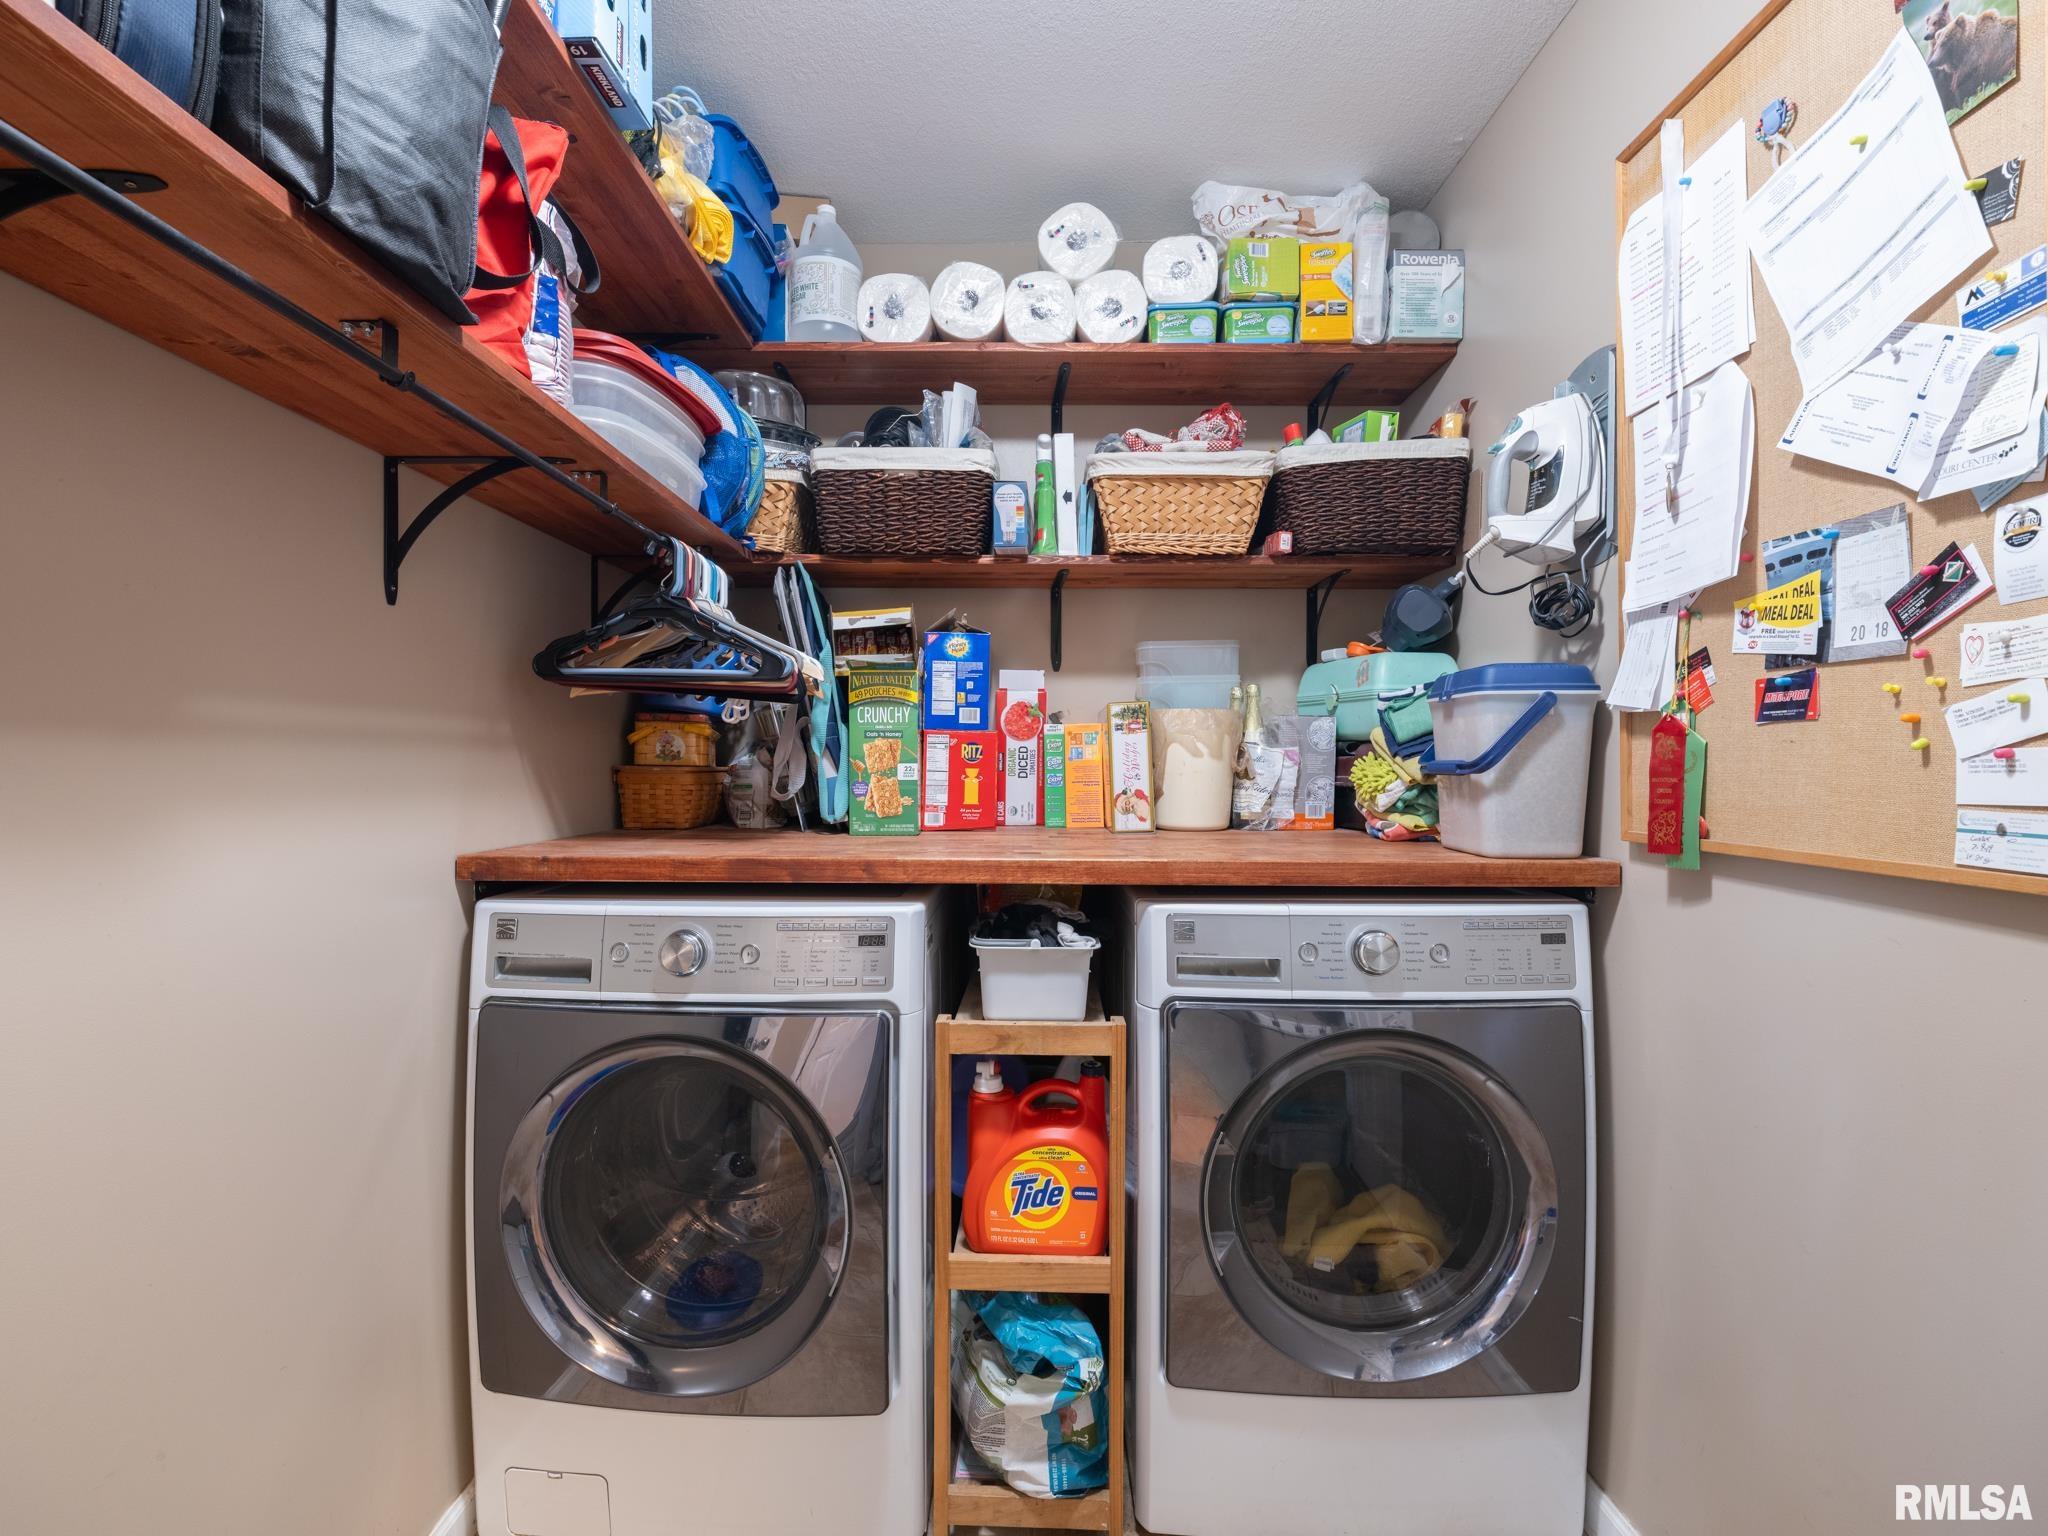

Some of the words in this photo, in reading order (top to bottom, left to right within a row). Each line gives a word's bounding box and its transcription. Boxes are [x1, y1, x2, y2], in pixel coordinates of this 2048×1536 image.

[590, 65, 623, 107] KIRKLAND
[1400, 253, 1461, 265] Rowenta
[800, 282, 819, 292] WHITE
[1761, 605, 1788, 620] MEAL
[1790, 603, 1815, 620] DEAL
[1851, 625, 1865, 641] 20
[1875, 621, 1889, 638] 18
[852, 675, 884, 688] NATURE
[885, 675, 914, 688] VALLEY
[854, 690, 863, 699] 49
[864, 687, 896, 697] POUCHES
[857, 706, 910, 723] CRUNCHY
[961, 743, 983, 760] RITZ
[1008, 747, 1016, 776] ORGANIC
[1018, 745, 1028, 779] DICED
[1010, 1177, 1066, 1217] Tide
